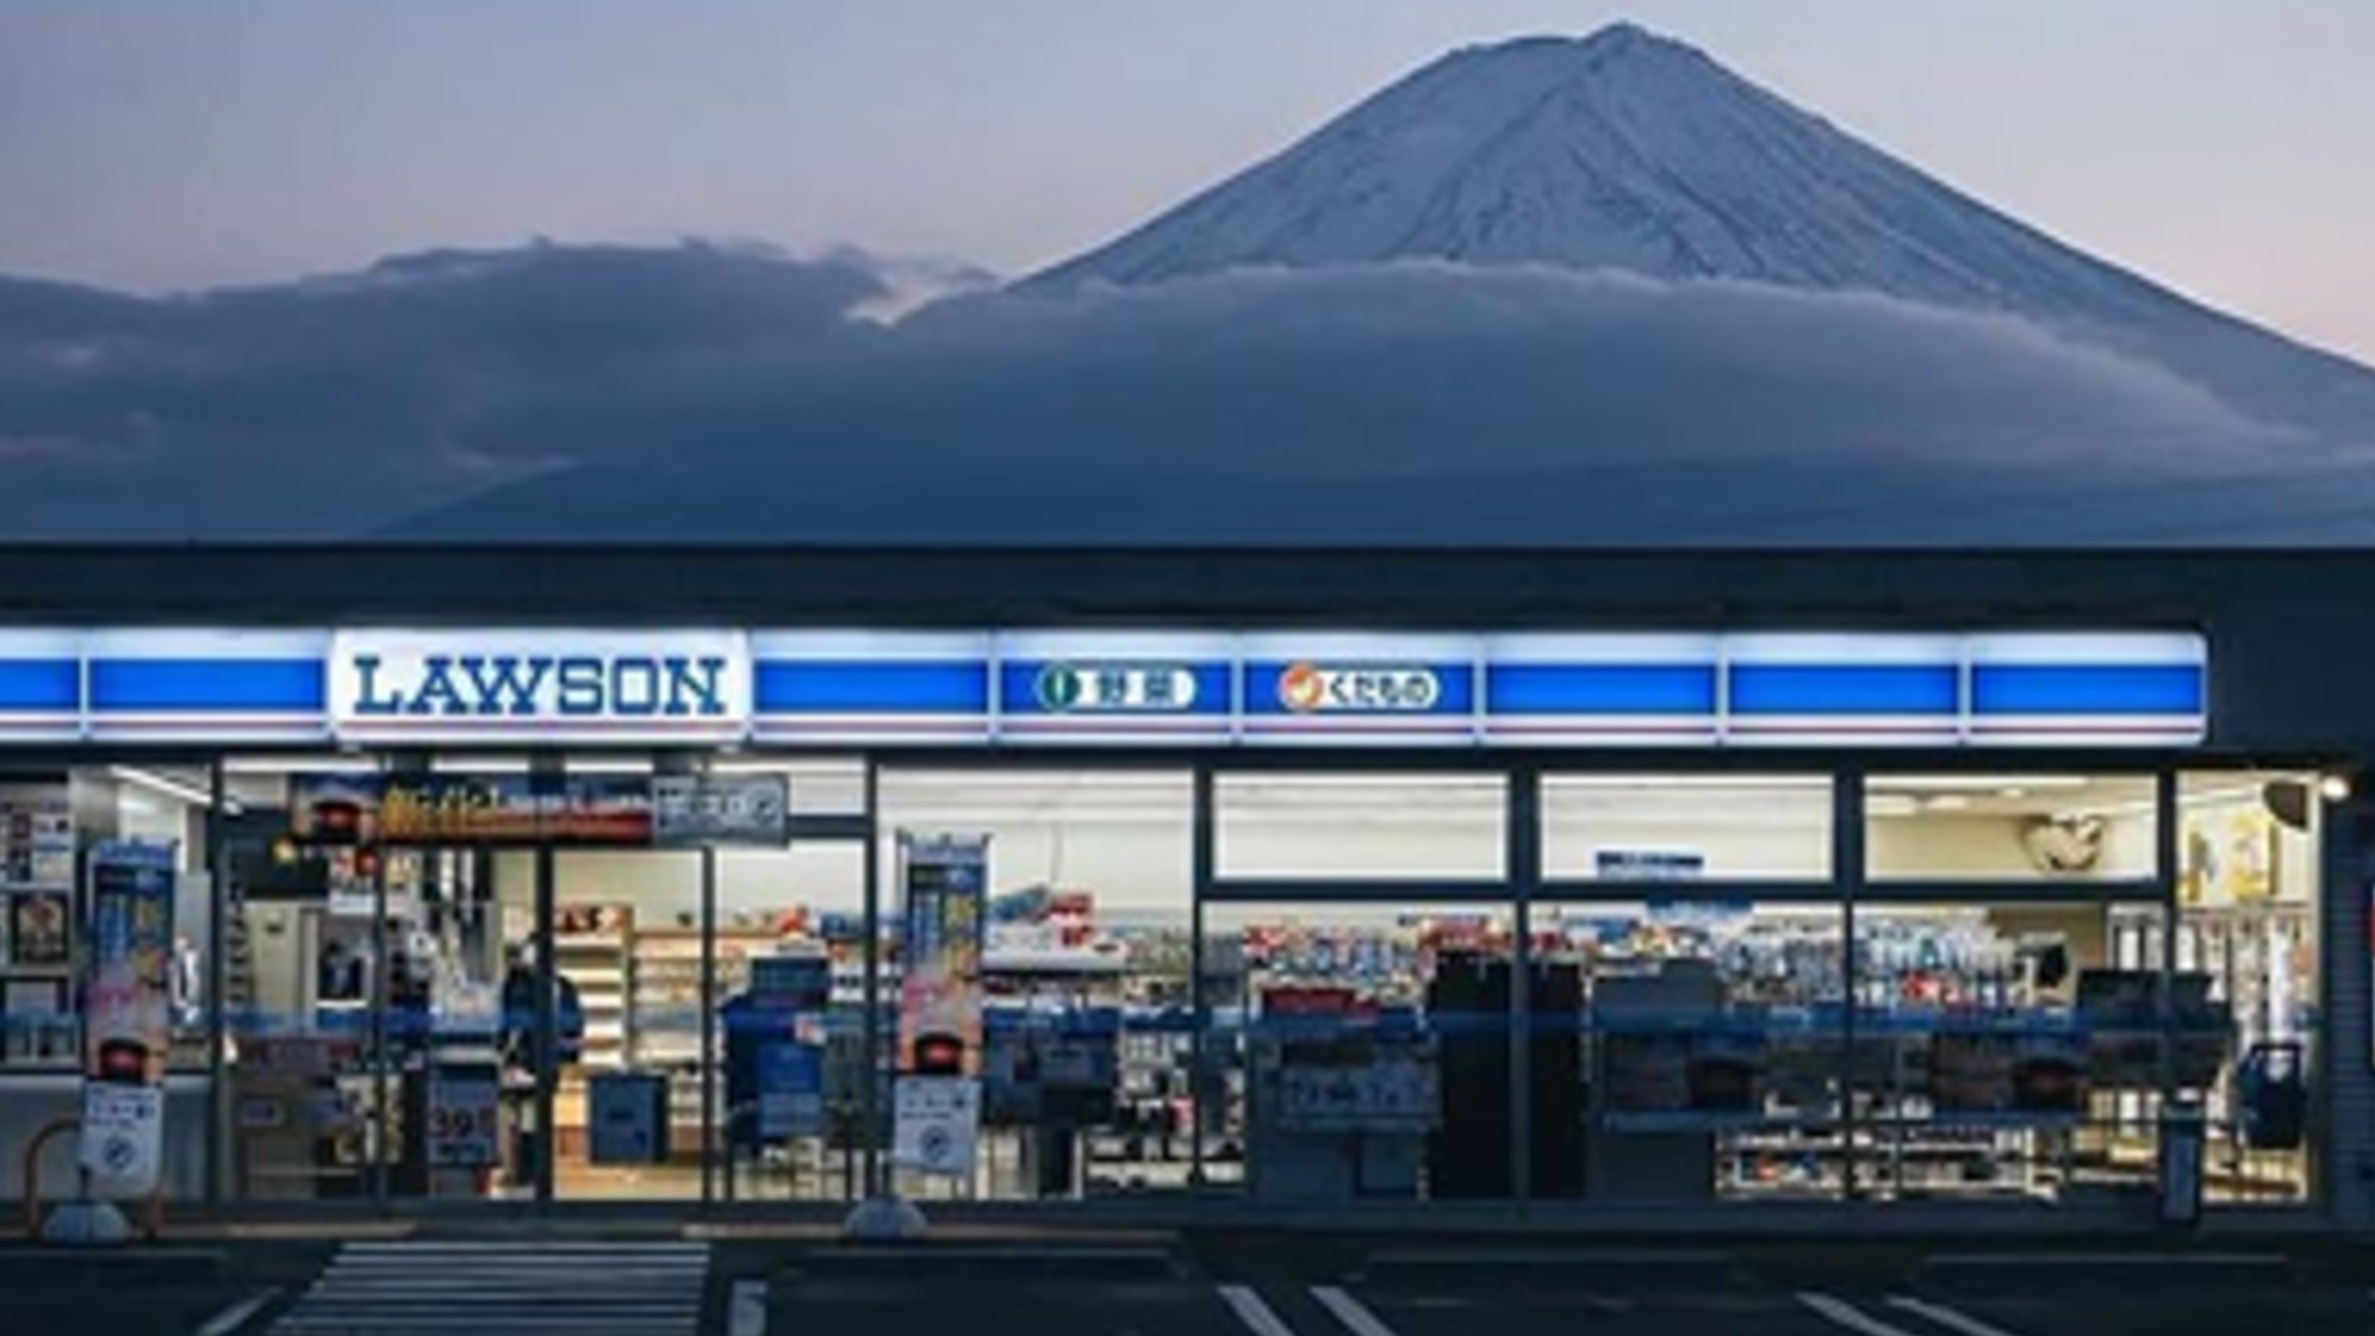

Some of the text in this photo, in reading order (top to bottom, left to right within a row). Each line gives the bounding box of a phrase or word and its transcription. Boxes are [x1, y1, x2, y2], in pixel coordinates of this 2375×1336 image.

[353, 656, 726, 716] LAWSON
[1329, 671, 1433, 706] くだもの
